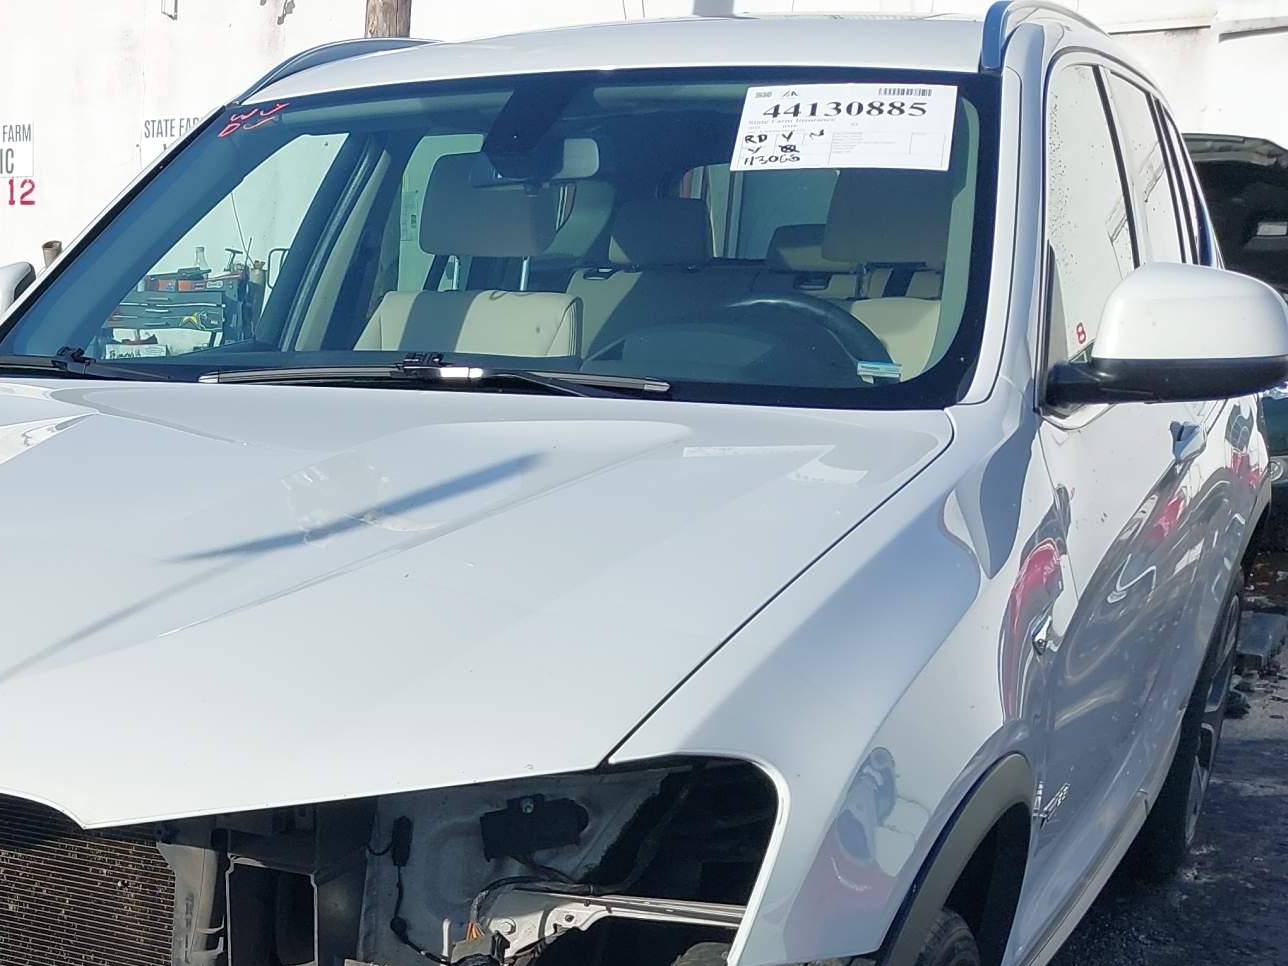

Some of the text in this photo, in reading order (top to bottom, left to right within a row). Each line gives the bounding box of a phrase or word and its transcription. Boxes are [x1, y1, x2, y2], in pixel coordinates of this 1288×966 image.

[762, 101, 928, 118] 44130885
[2, 123, 32, 143] FARM
[143, 119, 176, 138] STATE
[8, 178, 36, 206] 12
